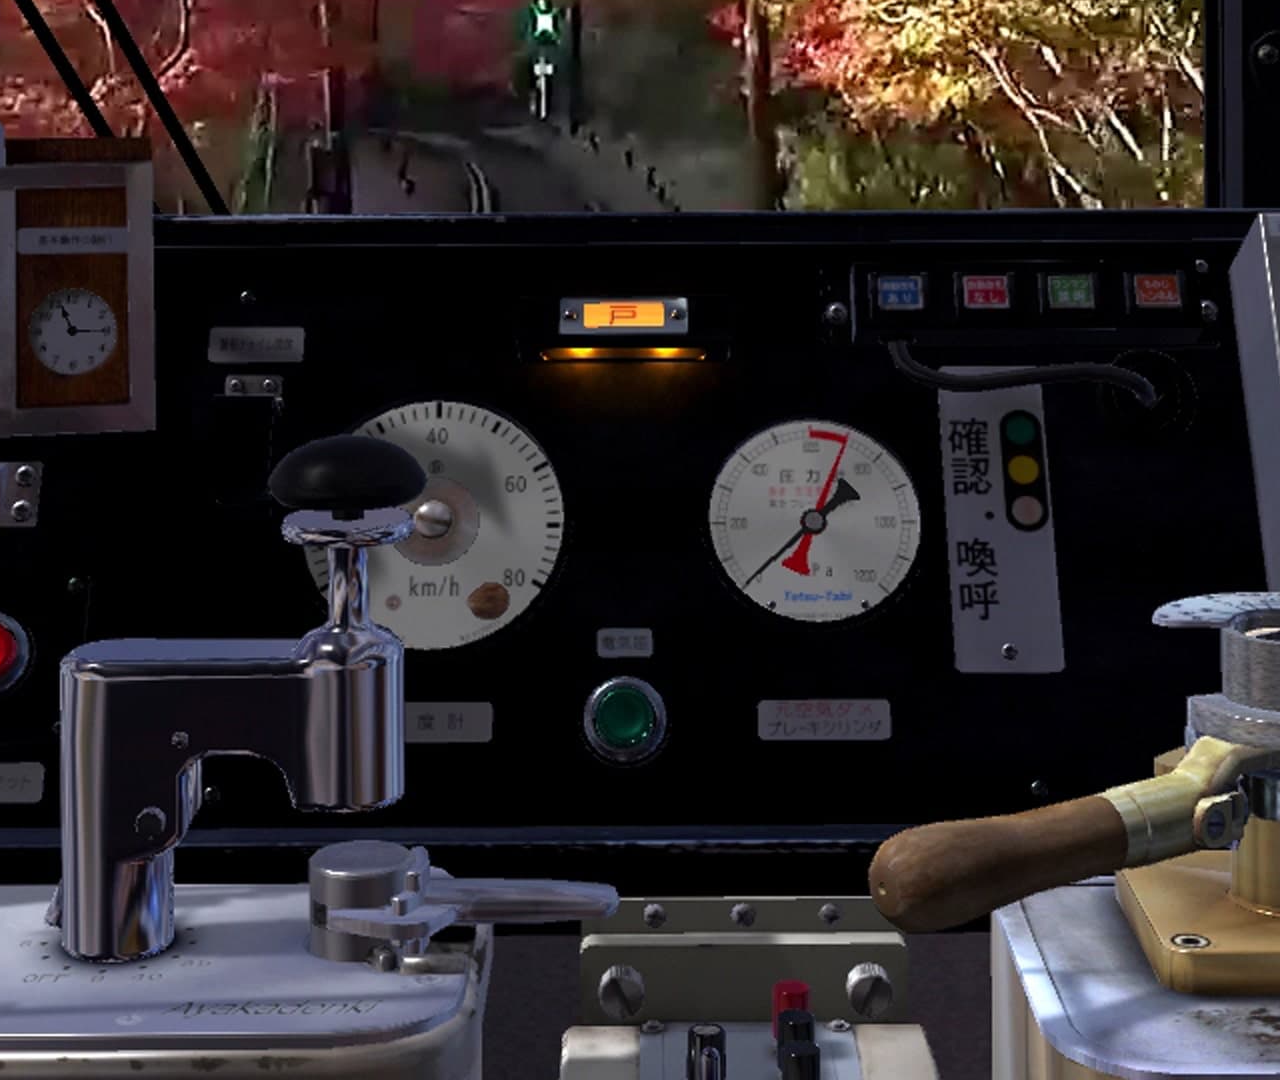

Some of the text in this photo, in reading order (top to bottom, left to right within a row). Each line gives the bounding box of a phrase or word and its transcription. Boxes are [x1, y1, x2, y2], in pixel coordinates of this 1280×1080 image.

[426, 427, 449, 445] 40
[505, 475, 528, 494] 60
[409, 575, 460, 598] km/h
[503, 568, 526, 587] 80
